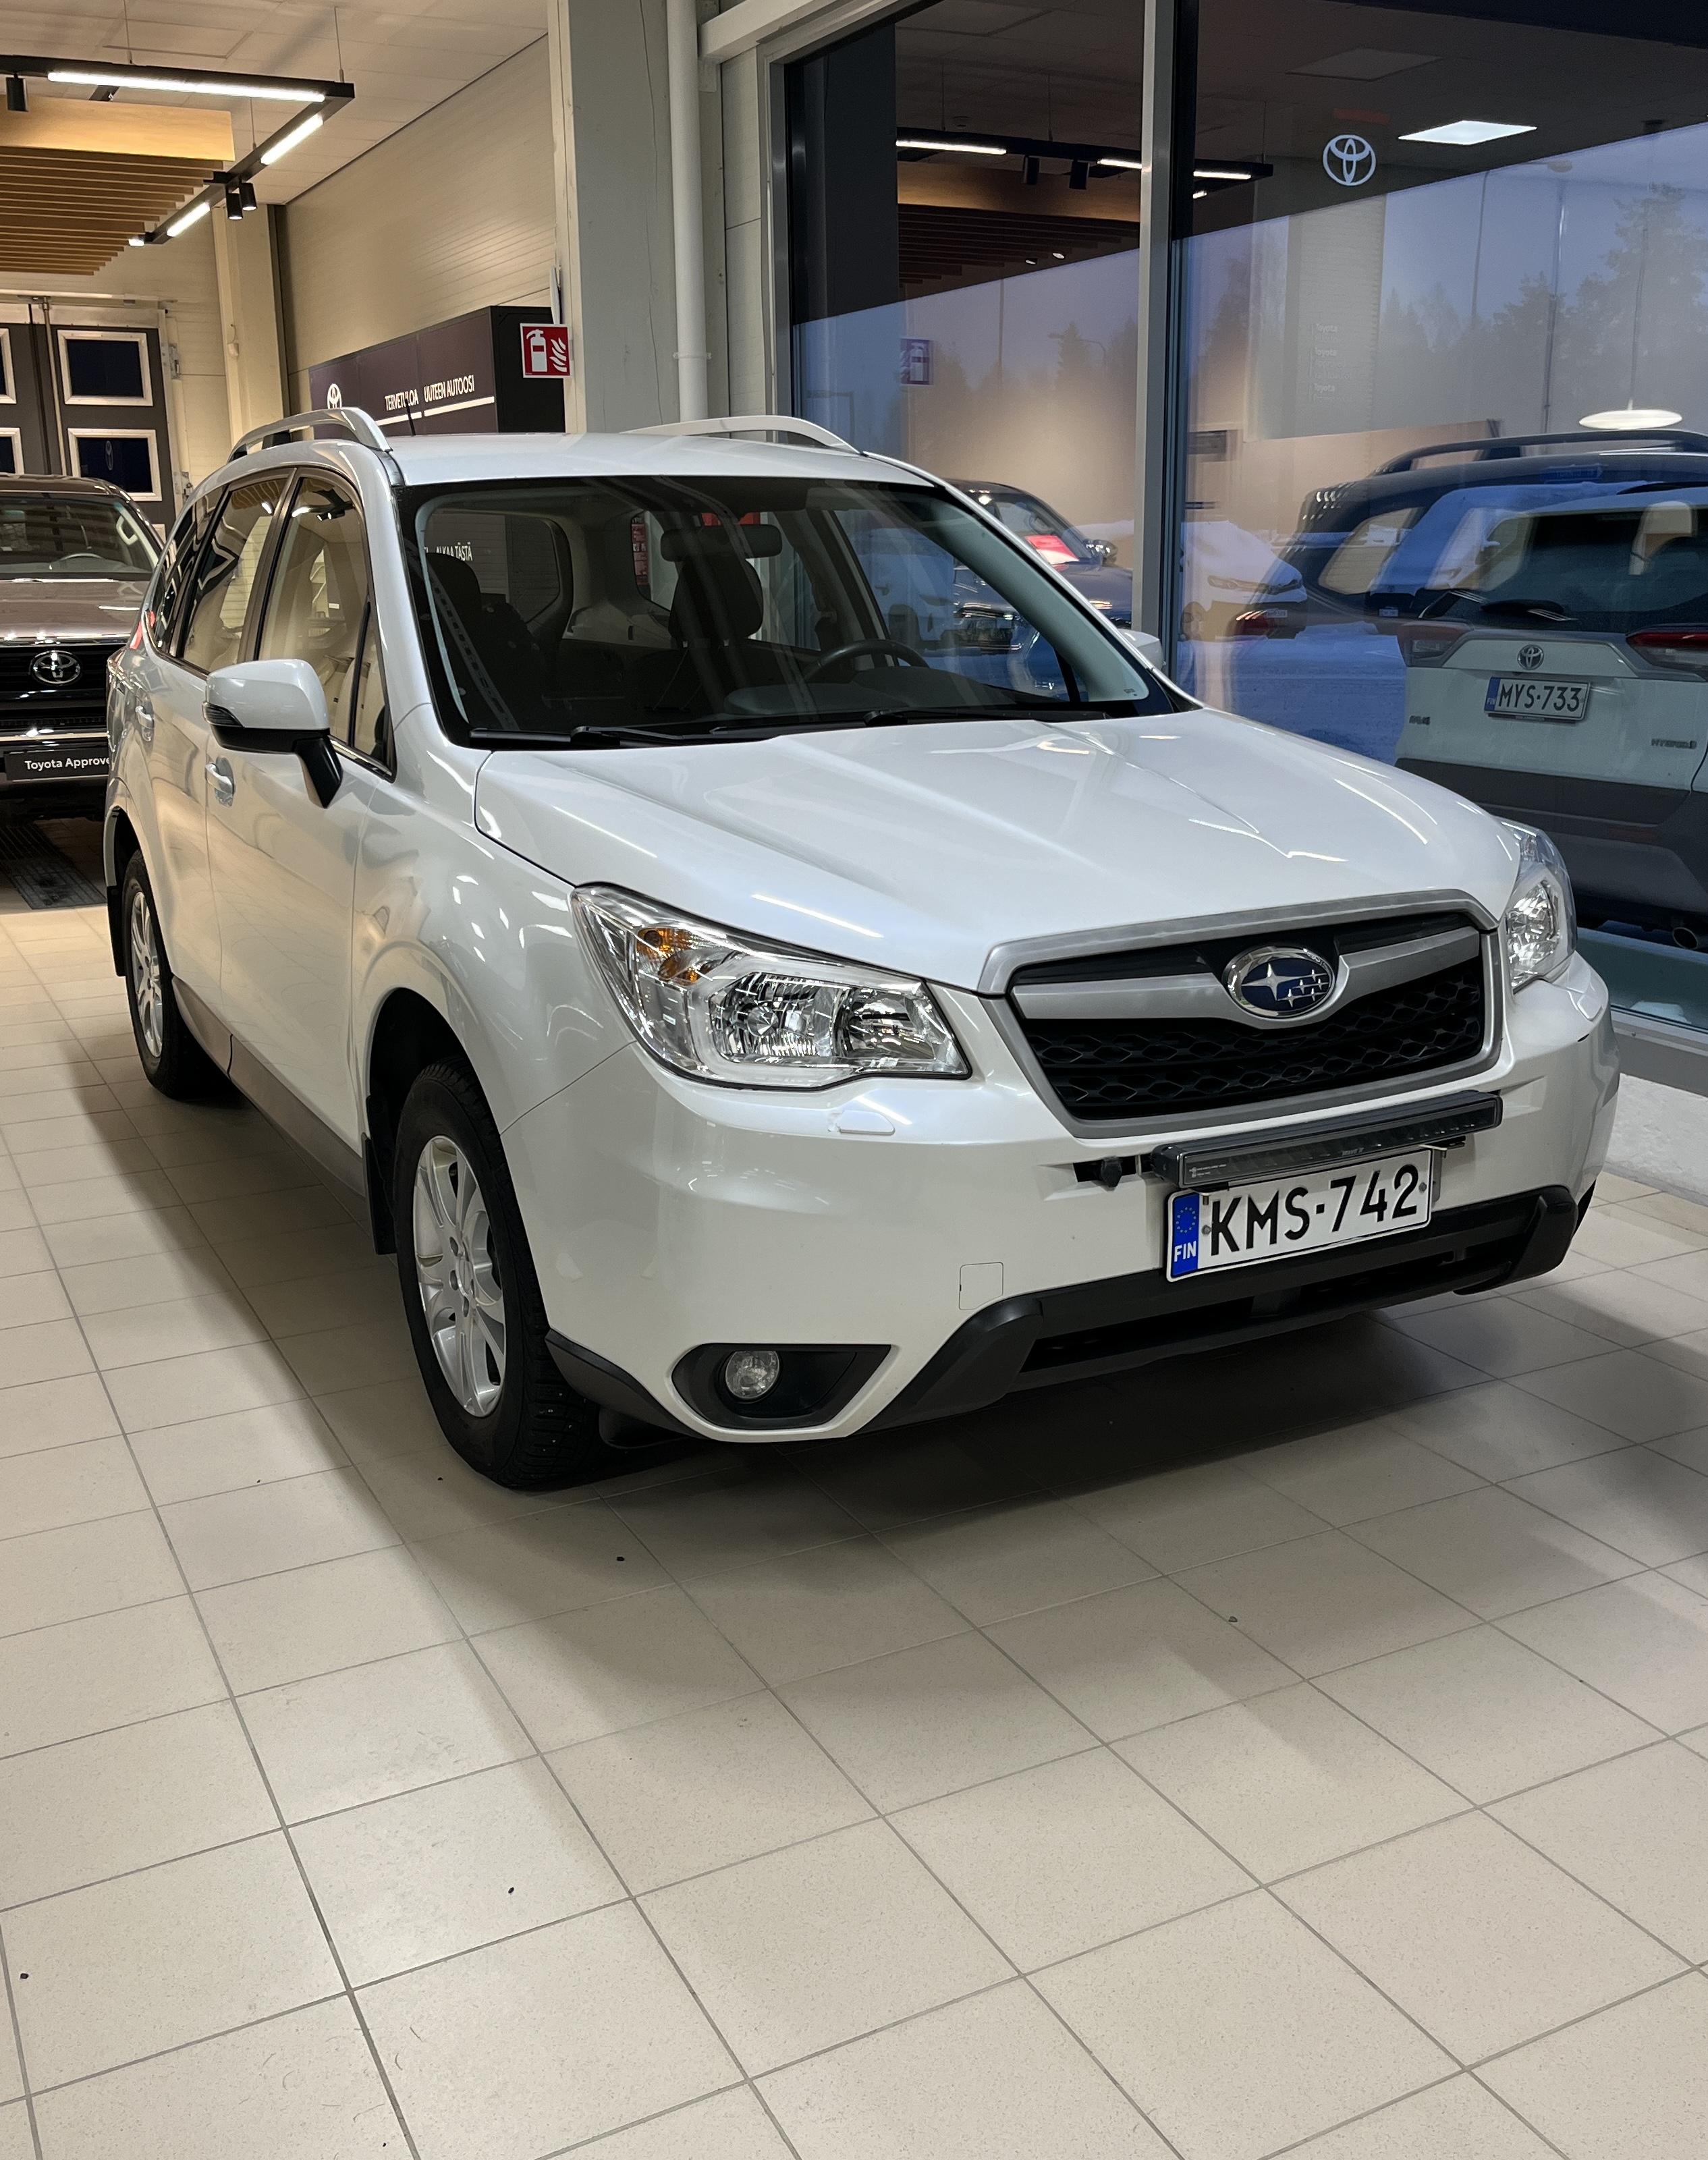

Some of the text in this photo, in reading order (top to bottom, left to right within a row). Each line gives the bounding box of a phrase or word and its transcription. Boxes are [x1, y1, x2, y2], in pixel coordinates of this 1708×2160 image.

[424, 381, 446, 403] UUTEEN
[447, 375, 475, 397] AUTOOSI
[455, 541, 473, 561] TÄSTÄ
[1498, 683, 1582, 712] MYS-733
[24, 759, 63, 771] Toyota
[1174, 1163, 1418, 1263] FIN KMS-742
